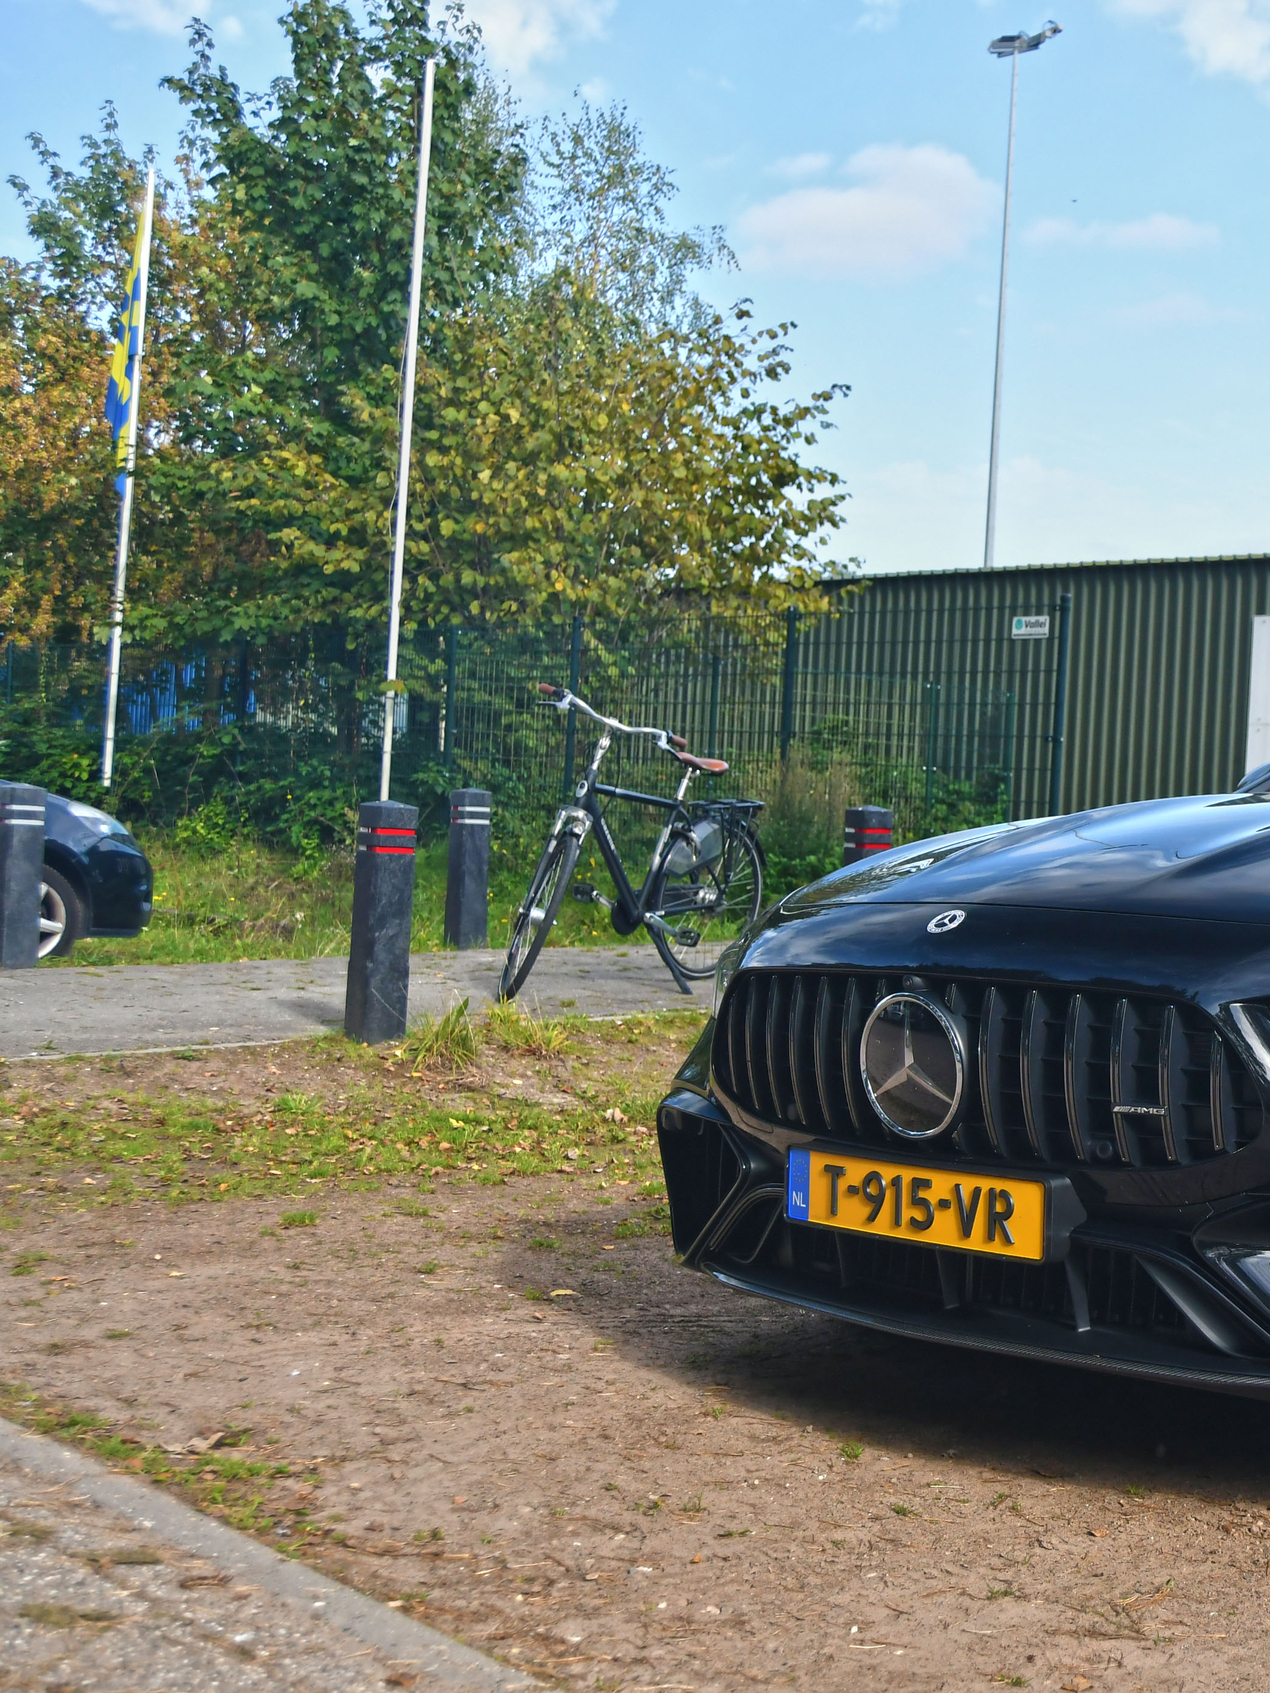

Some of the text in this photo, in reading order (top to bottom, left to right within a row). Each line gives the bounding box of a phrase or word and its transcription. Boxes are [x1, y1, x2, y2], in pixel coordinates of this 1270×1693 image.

[1129, 1106, 1165, 1115] AMG
[792, 1190, 806, 1208] NL
[823, 1164, 1015, 1244] T-915-VR
